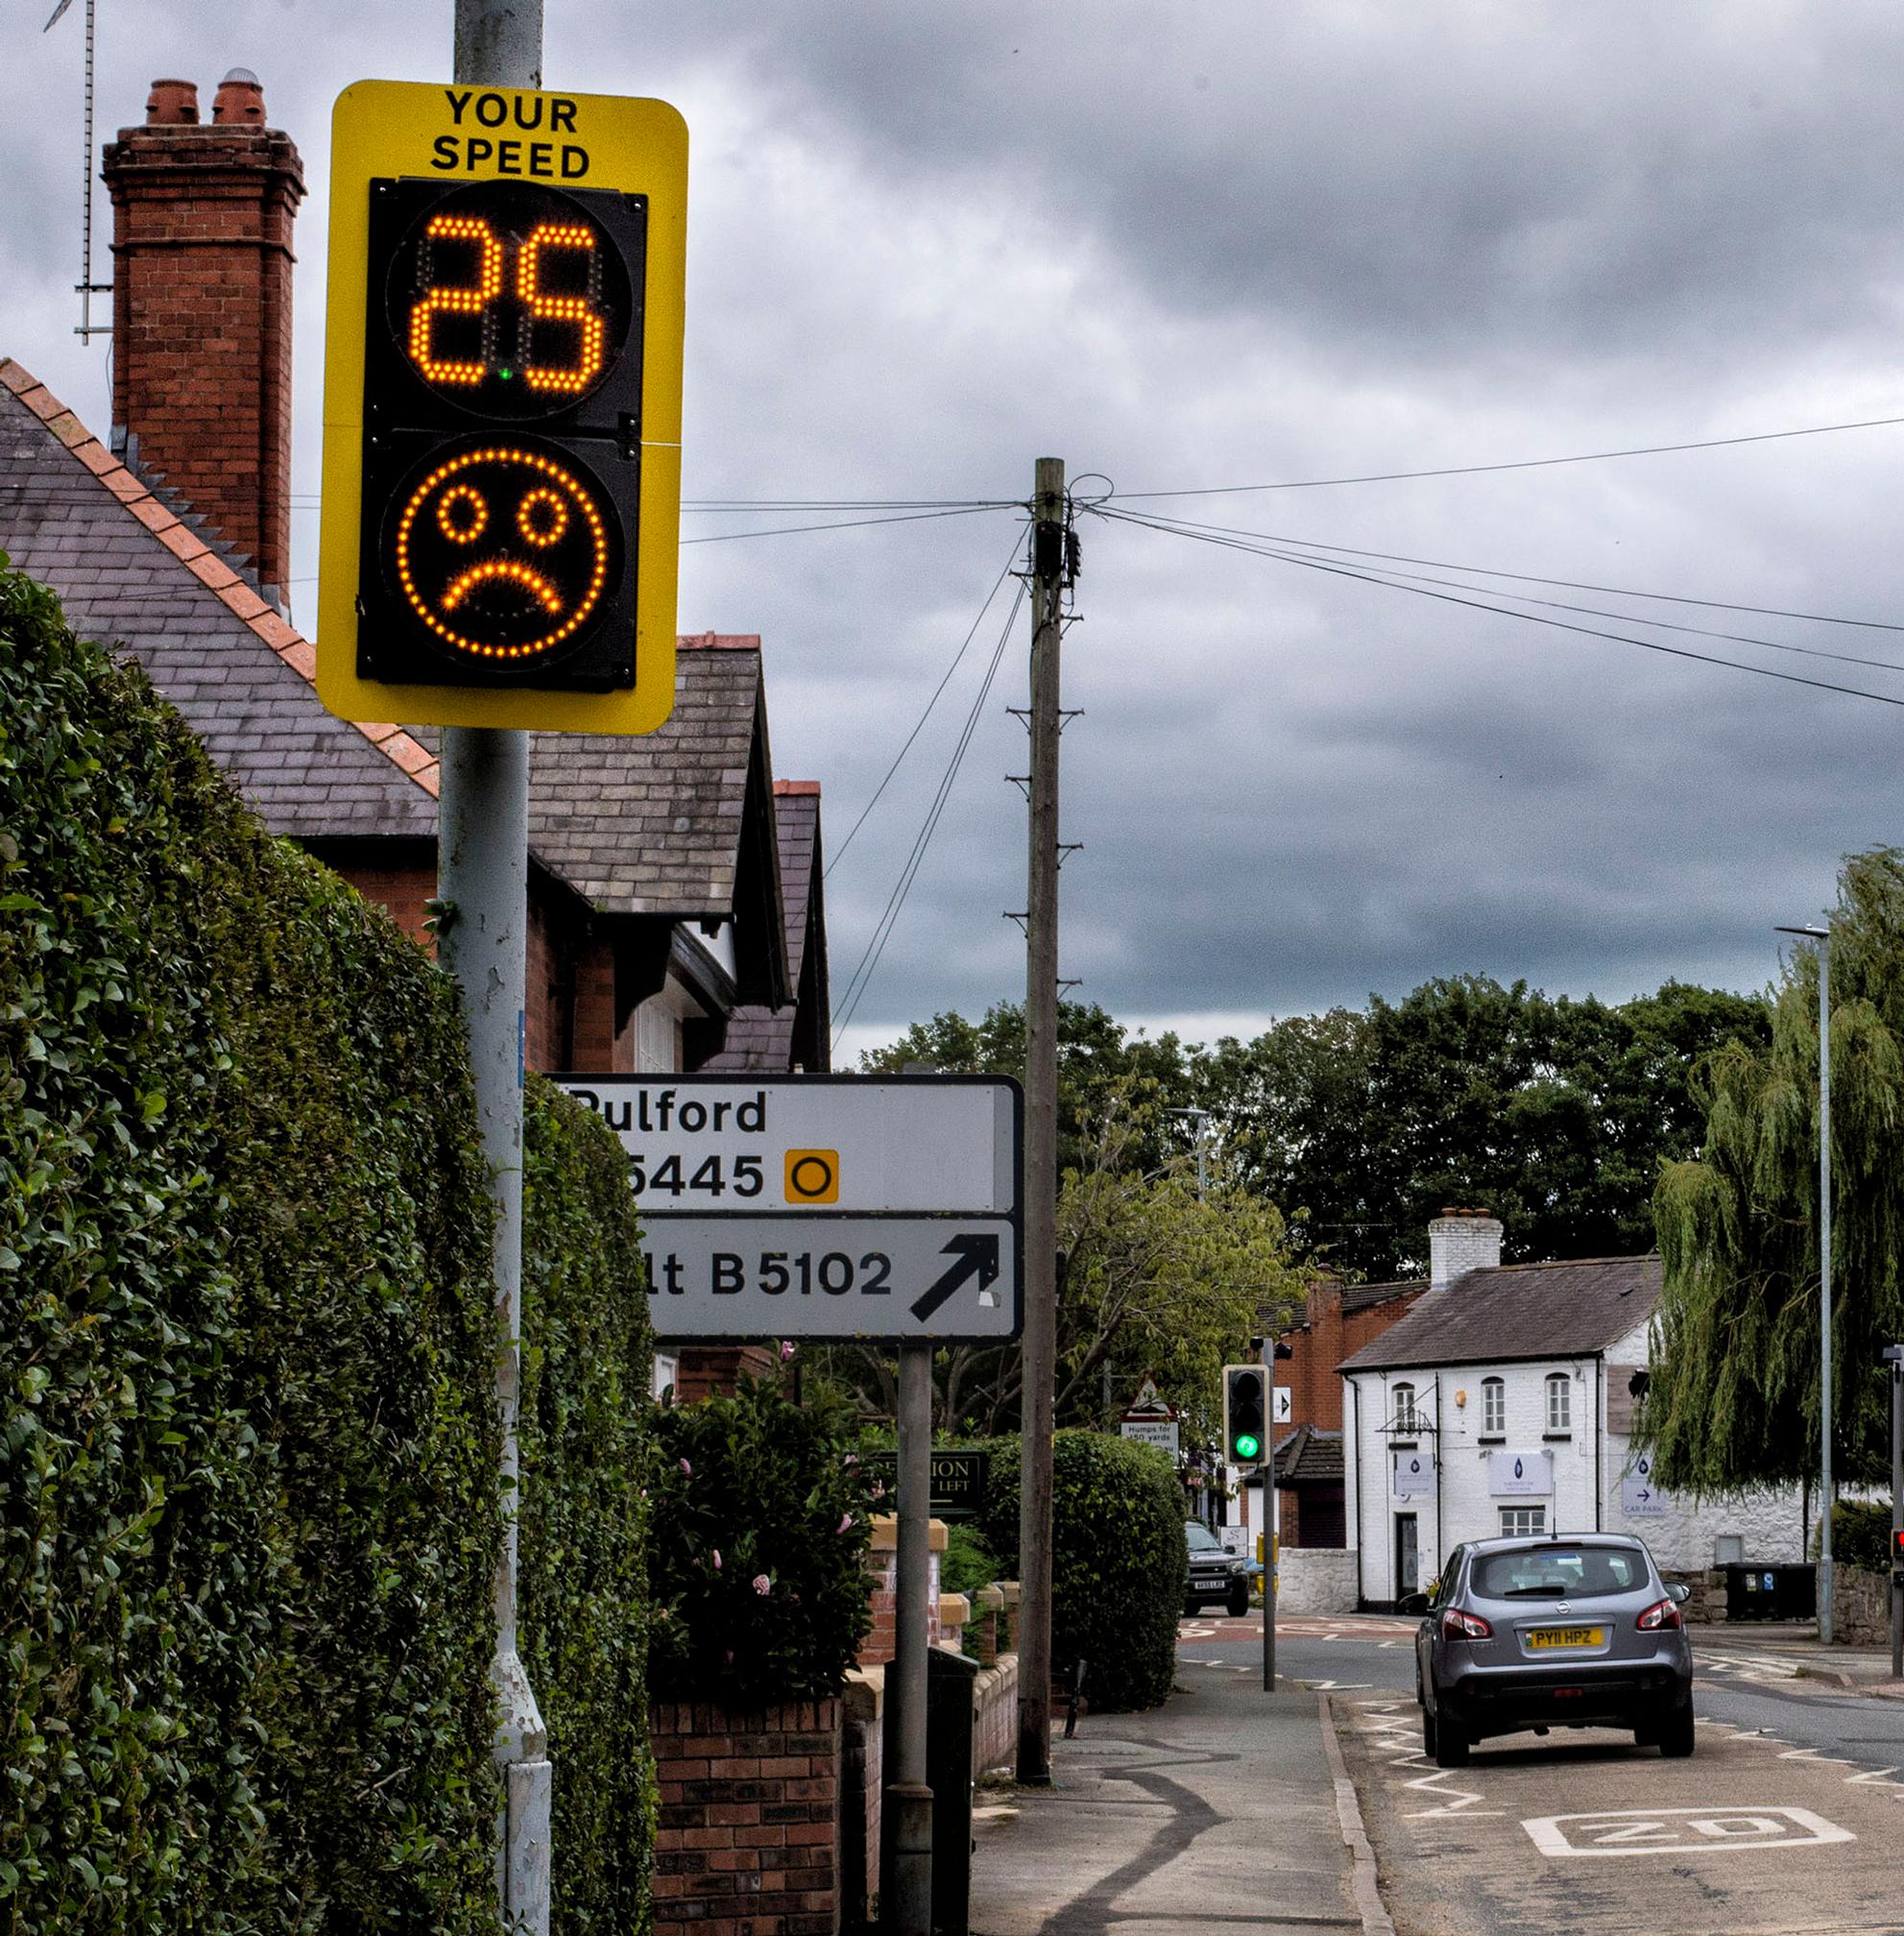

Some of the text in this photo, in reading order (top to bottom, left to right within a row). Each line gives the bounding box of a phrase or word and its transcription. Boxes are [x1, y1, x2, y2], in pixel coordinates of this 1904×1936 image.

[446, 90, 578, 133] YOUR
[430, 135, 590, 179] SPEED
[410, 215, 604, 390] 25
[1128, 1425, 1157, 1434] Humps
[1147, 1433, 1170, 1441] yards
[939, 1480, 970, 1491] LEFT
[1536, 1630, 1592, 1645] PY11 HPZ
[1579, 1817, 1787, 1844] 20
